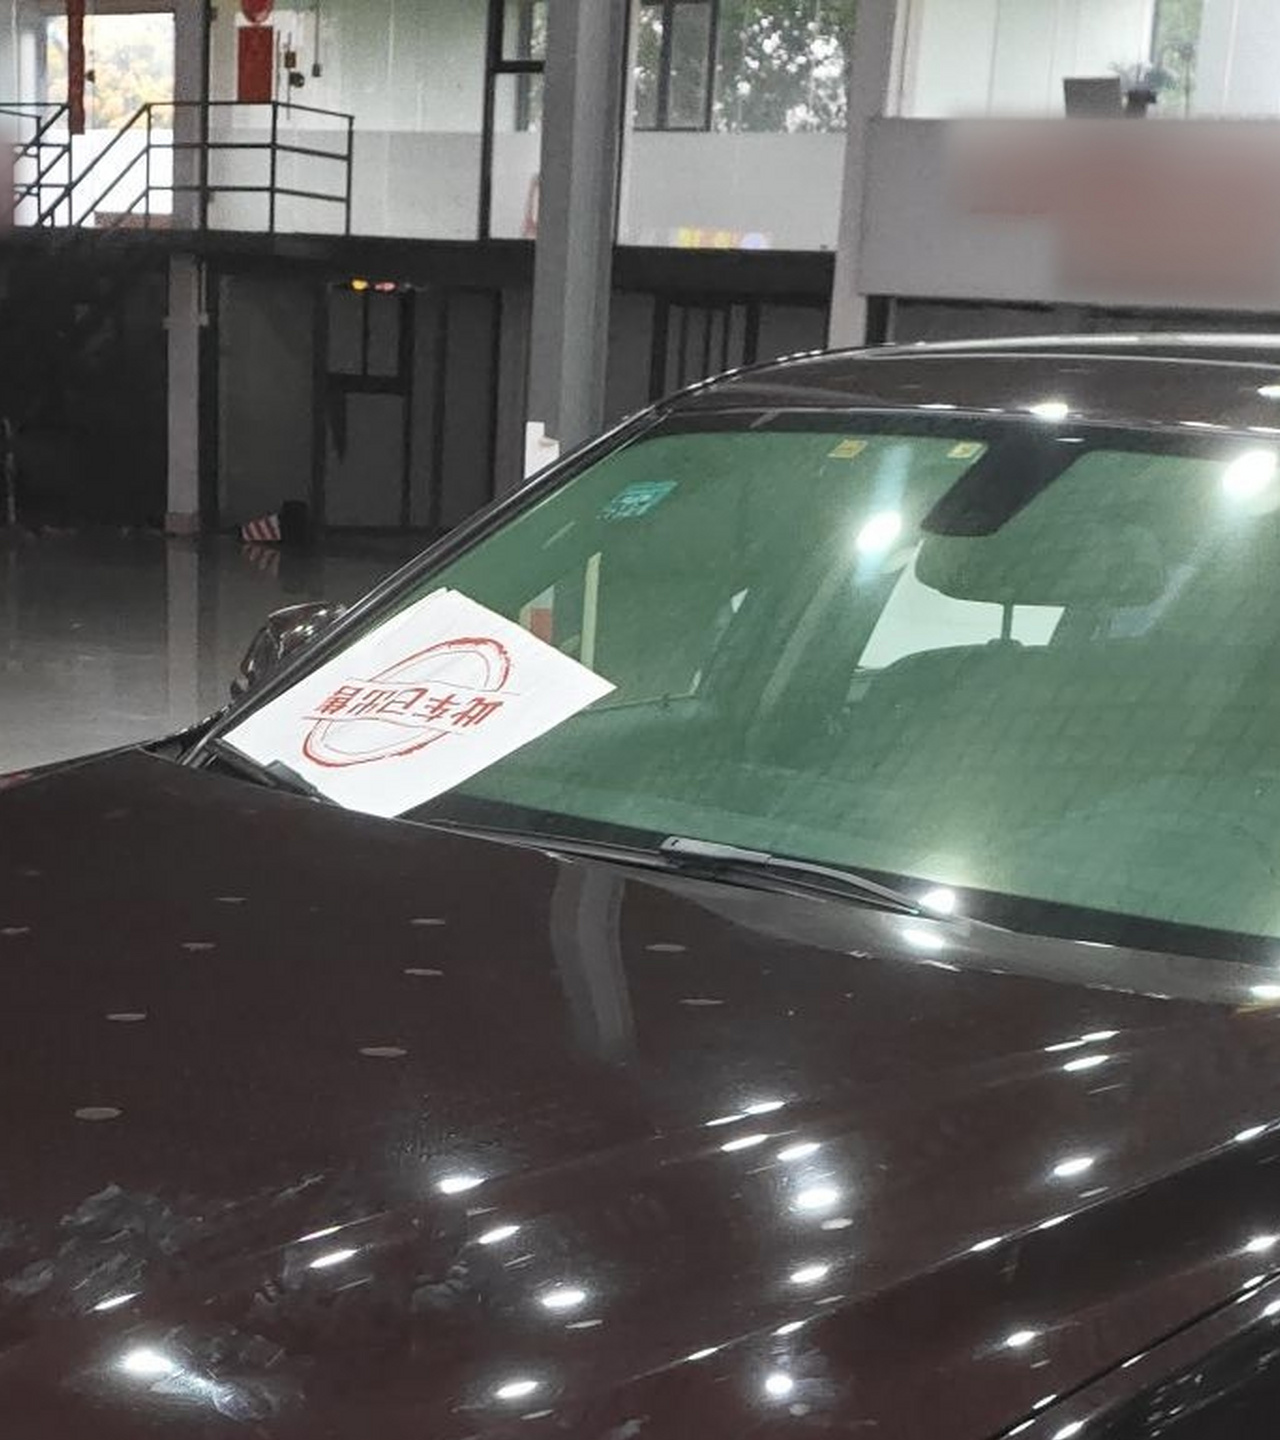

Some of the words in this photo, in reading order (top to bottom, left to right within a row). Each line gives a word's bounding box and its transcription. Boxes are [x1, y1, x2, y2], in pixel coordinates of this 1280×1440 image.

[314, 686, 505, 728] 此车已出售
